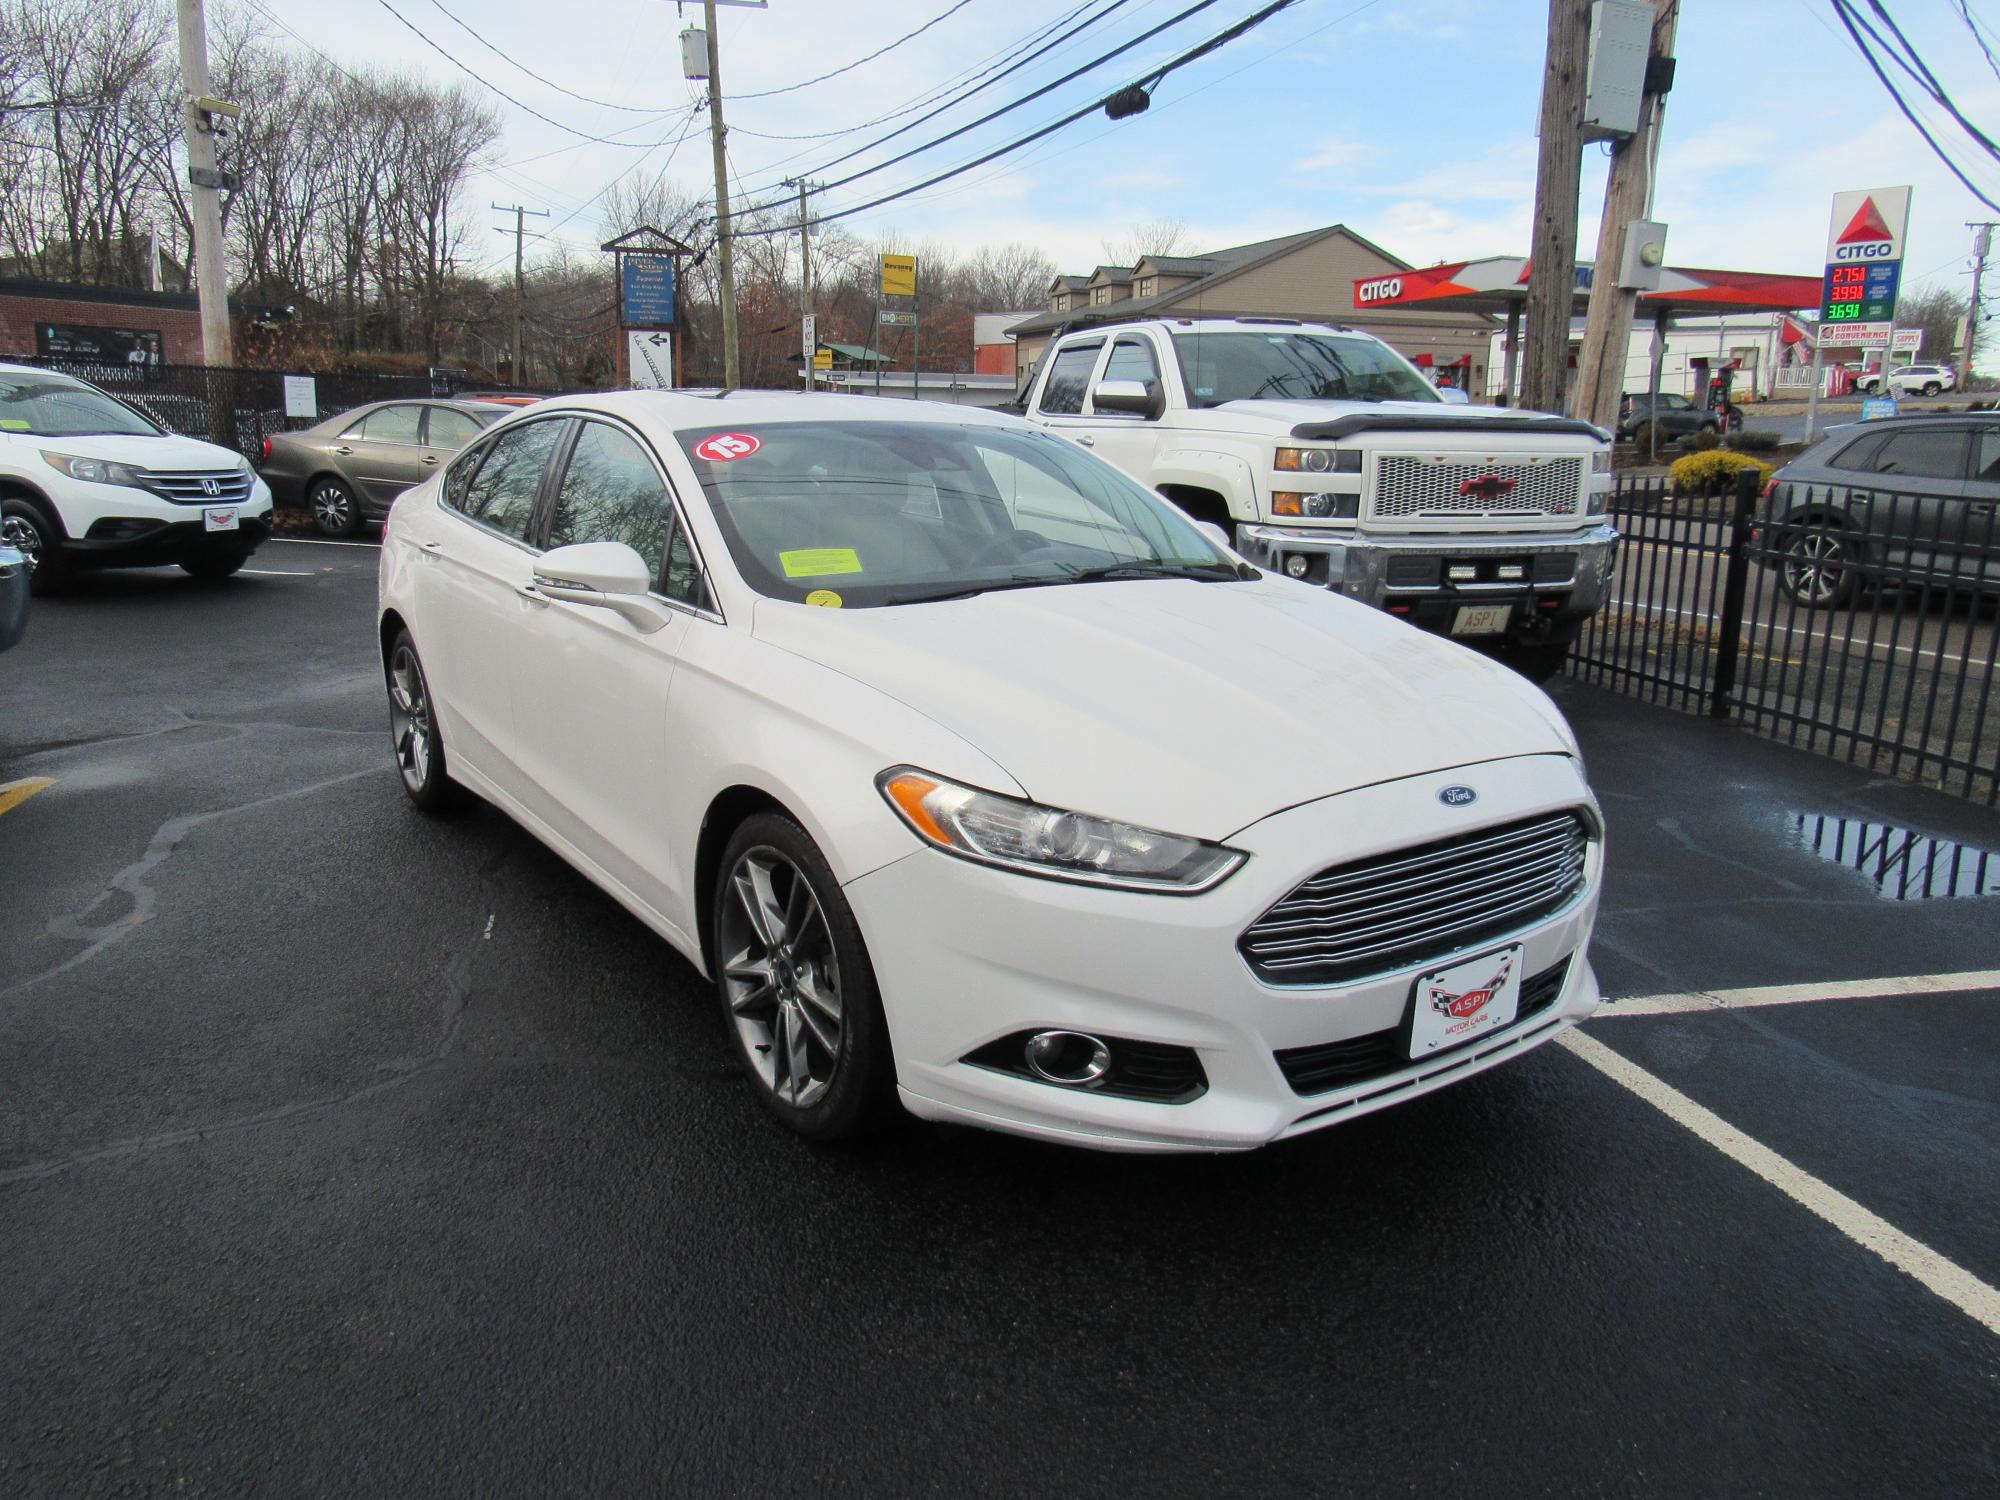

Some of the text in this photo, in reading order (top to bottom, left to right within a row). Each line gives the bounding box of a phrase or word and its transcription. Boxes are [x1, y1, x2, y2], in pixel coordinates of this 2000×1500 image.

[1836, 243, 1892, 259] CITGO
[1359, 278, 1401, 302] CITGO
[805, 318, 812, 328] DO
[1835, 324, 1867, 332] CORNER
[1835, 331, 1889, 340] CONVENIENCE
[707, 436, 750, 458] 15
[1464, 610, 1497, 628] ASPI
[1446, 789, 1472, 803] Ford
[1453, 992, 1486, 1013] ASPI
[1444, 1020, 1470, 1036] MOTOR
[1470, 1013, 1489, 1026] CARS
